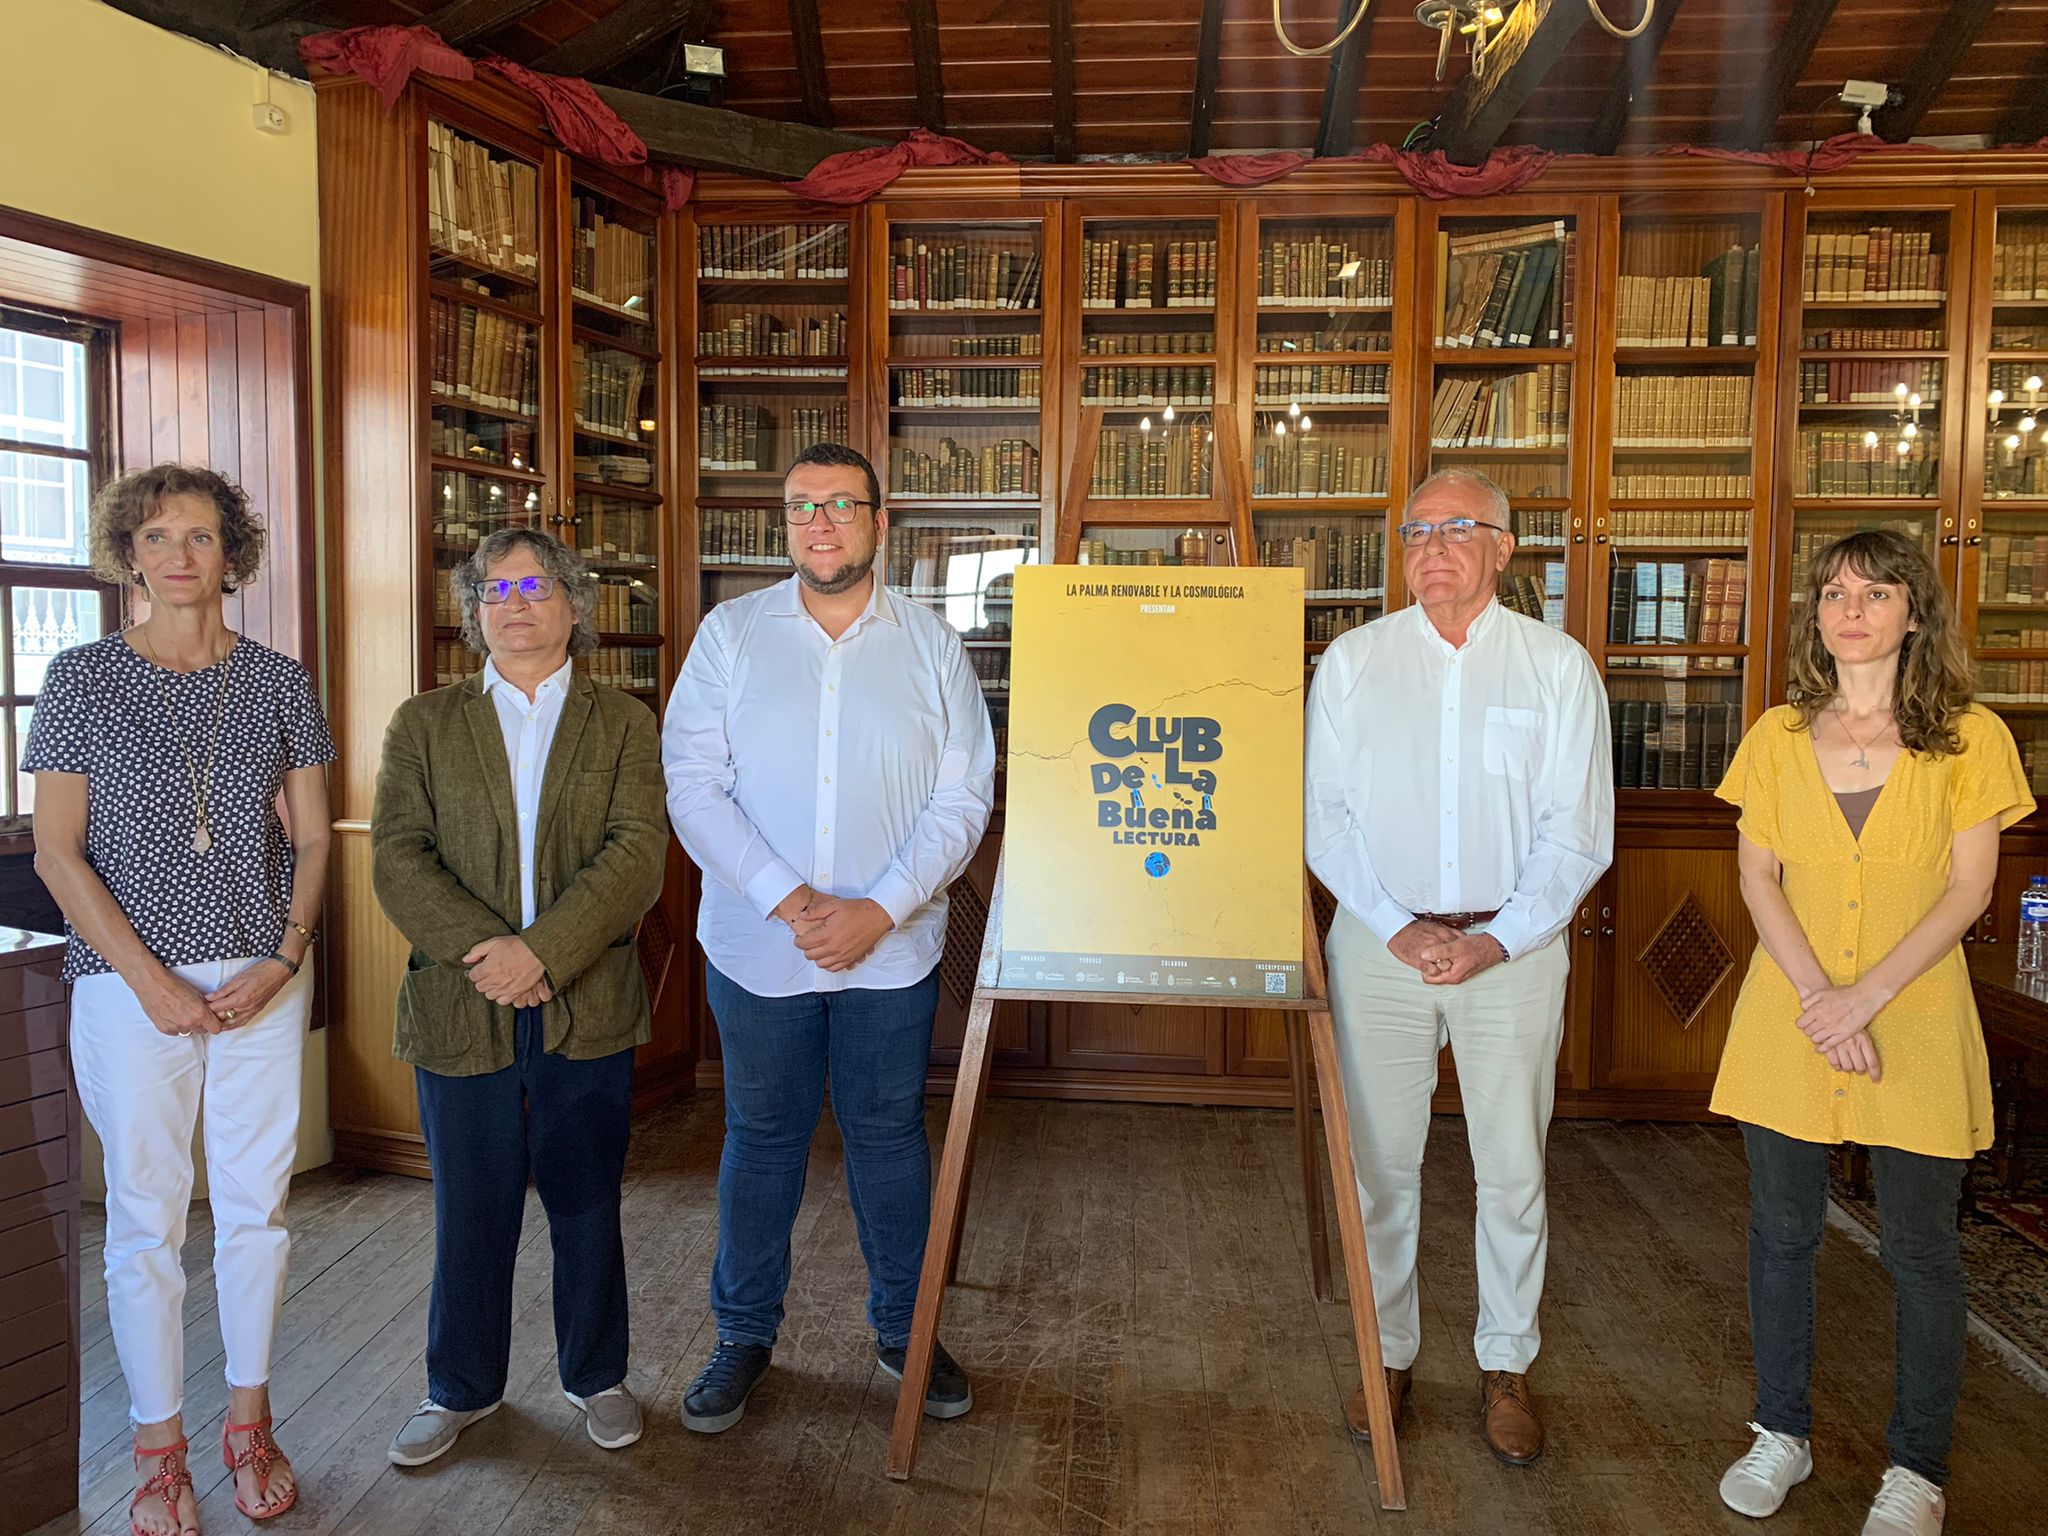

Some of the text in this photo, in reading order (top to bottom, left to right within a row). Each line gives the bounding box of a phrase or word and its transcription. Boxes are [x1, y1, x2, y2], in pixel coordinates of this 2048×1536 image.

[1066, 583, 1244, 599] LA PALMA RENOVABLE Y LA COSMOLÓGICA
[1140, 604, 1175, 614] PRESENTAN
[1090, 747, 1217, 795] De La
[1098, 800, 1217, 830] Buena
[1113, 831, 1200, 847] LECTURA
[1255, 963, 1296, 971] INSCRIPCIONES
